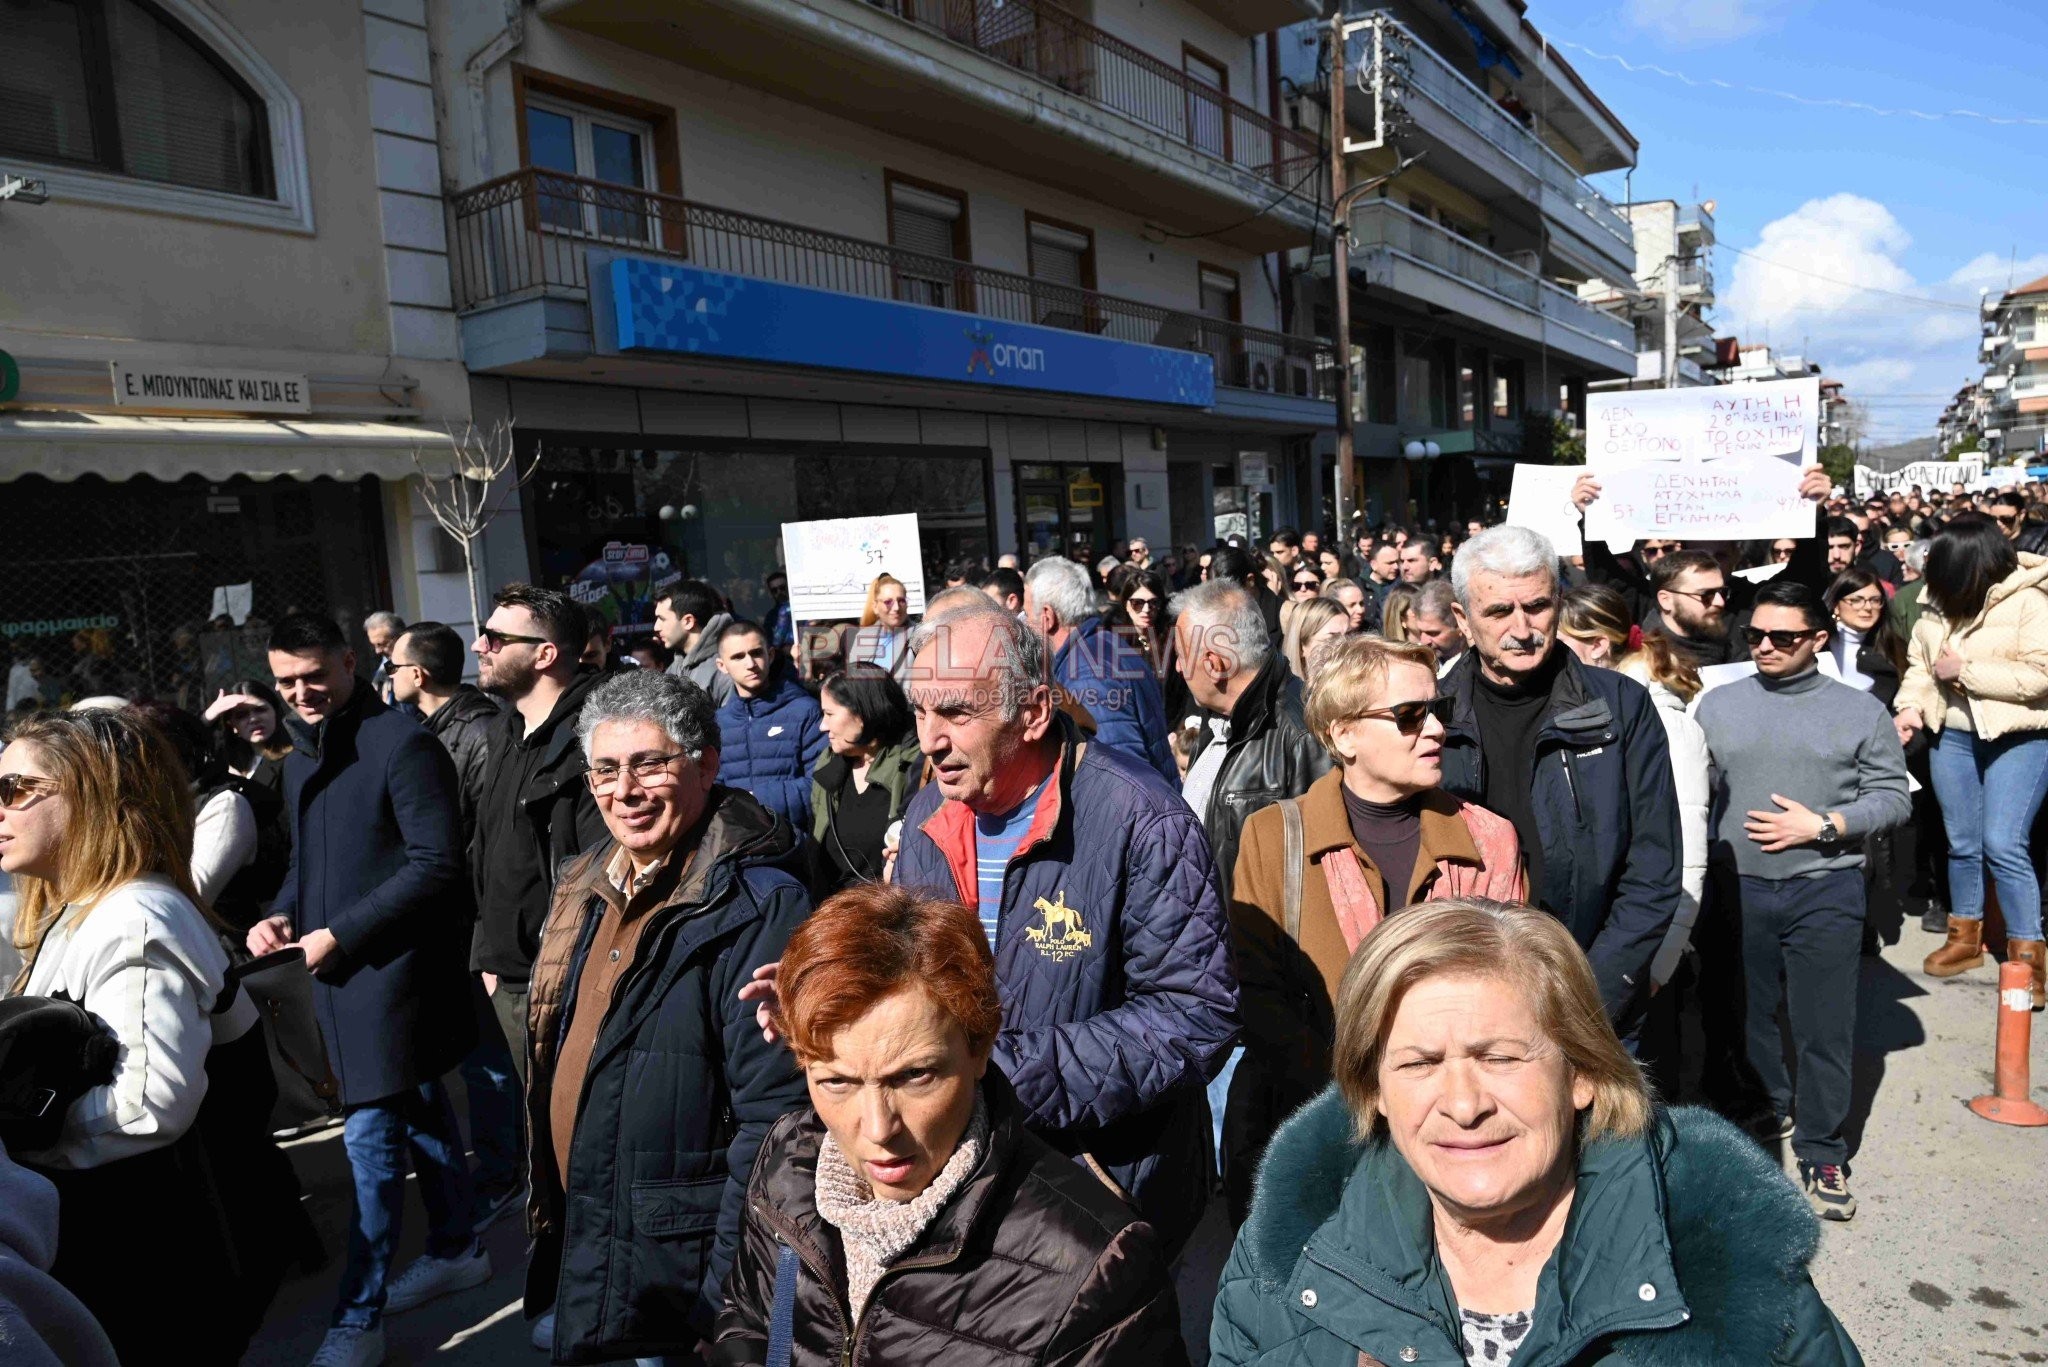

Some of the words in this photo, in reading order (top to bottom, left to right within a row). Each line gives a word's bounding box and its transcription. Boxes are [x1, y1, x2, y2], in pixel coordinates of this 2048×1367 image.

[125, 373, 139, 396] Ε.
[142, 374, 235, 400] ΜΠΟΥΝΤΩΝΑΣ
[238, 379, 258, 400] ΚΑΙ
[262, 381, 283, 402] ΣΙΑ
[284, 382, 300, 403] ΕΕ
[1712, 397, 1770, 410] ΑΥΤΗ
[1784, 394, 1801, 410] Η
[1655, 473, 1695, 489] ΔΕΝ
[1613, 503, 1635, 521] 57
[866, 549, 884, 566] 57
[569, 579, 593, 597] BET
[1035, 942, 1054, 950] RALPH
[1056, 943, 1082, 951] LAUREN
[1051, 950, 1064, 963] 12
